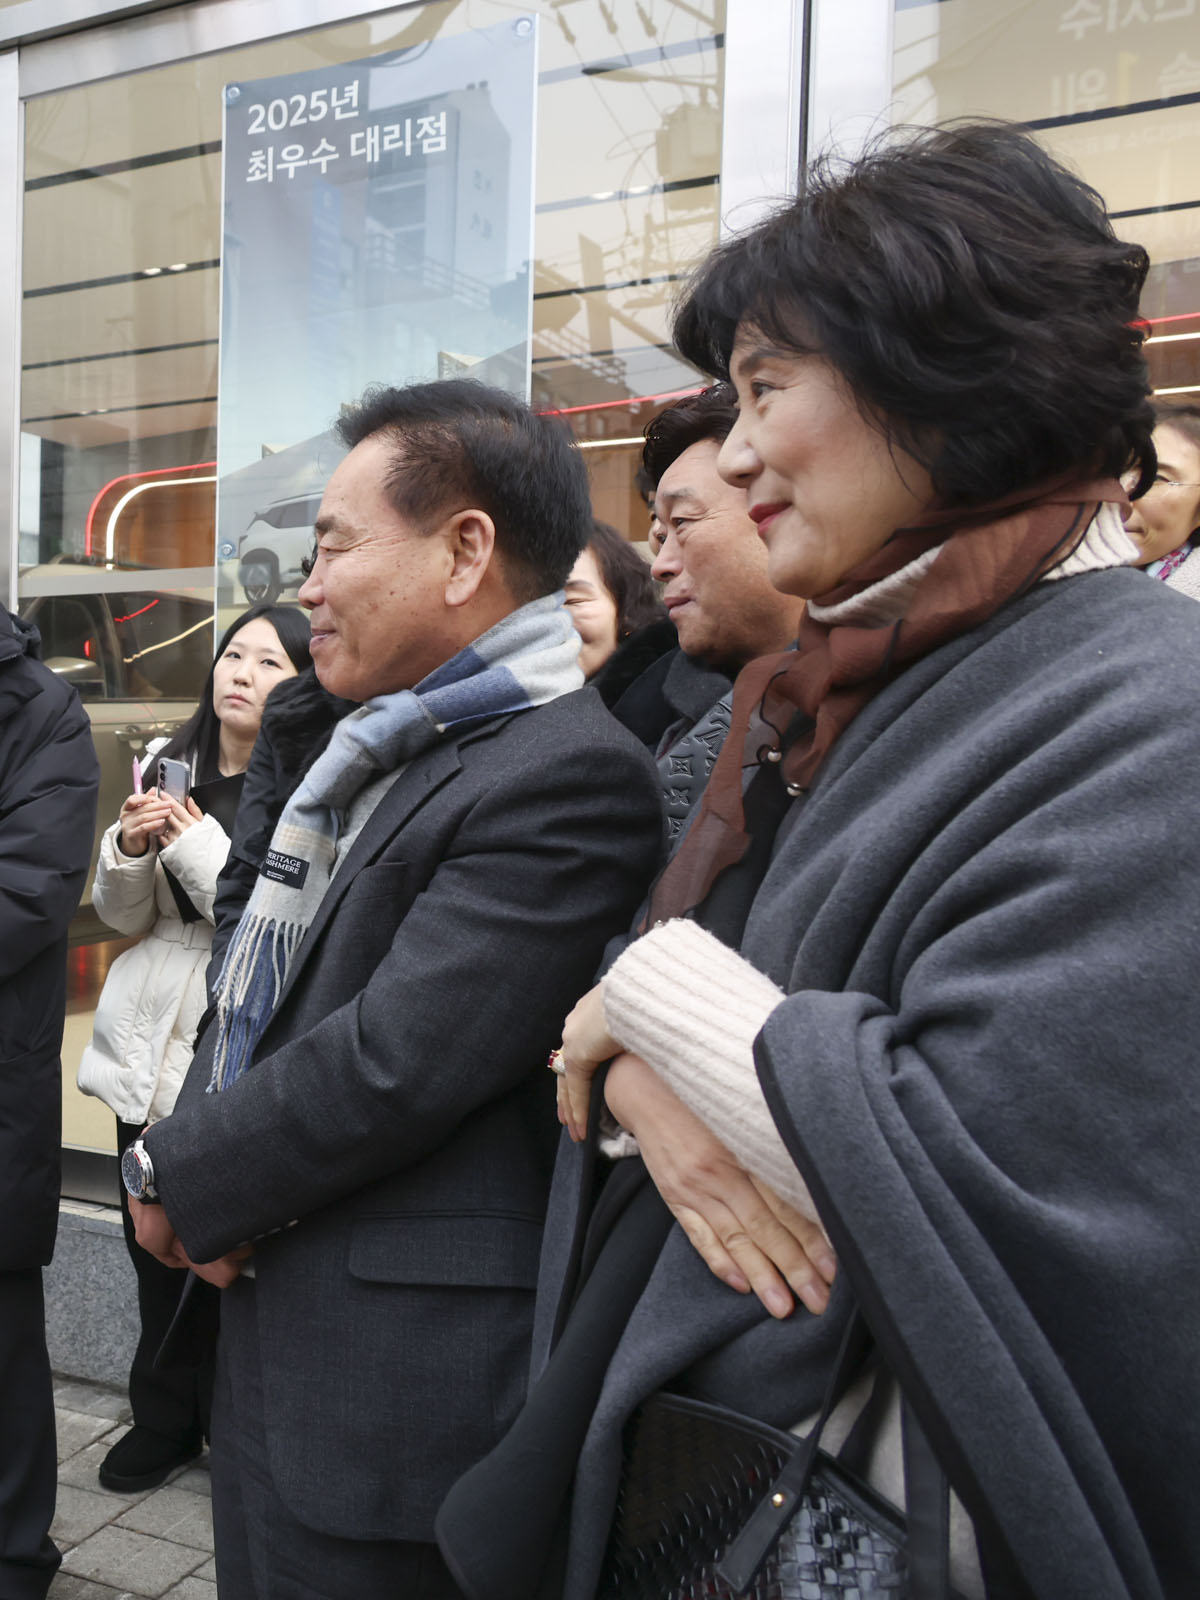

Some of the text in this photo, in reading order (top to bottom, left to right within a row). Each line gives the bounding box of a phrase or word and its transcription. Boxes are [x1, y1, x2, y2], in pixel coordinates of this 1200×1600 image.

[247, 79, 360, 136] 2025년
[245, 112, 448, 183] 최우수 대리점
